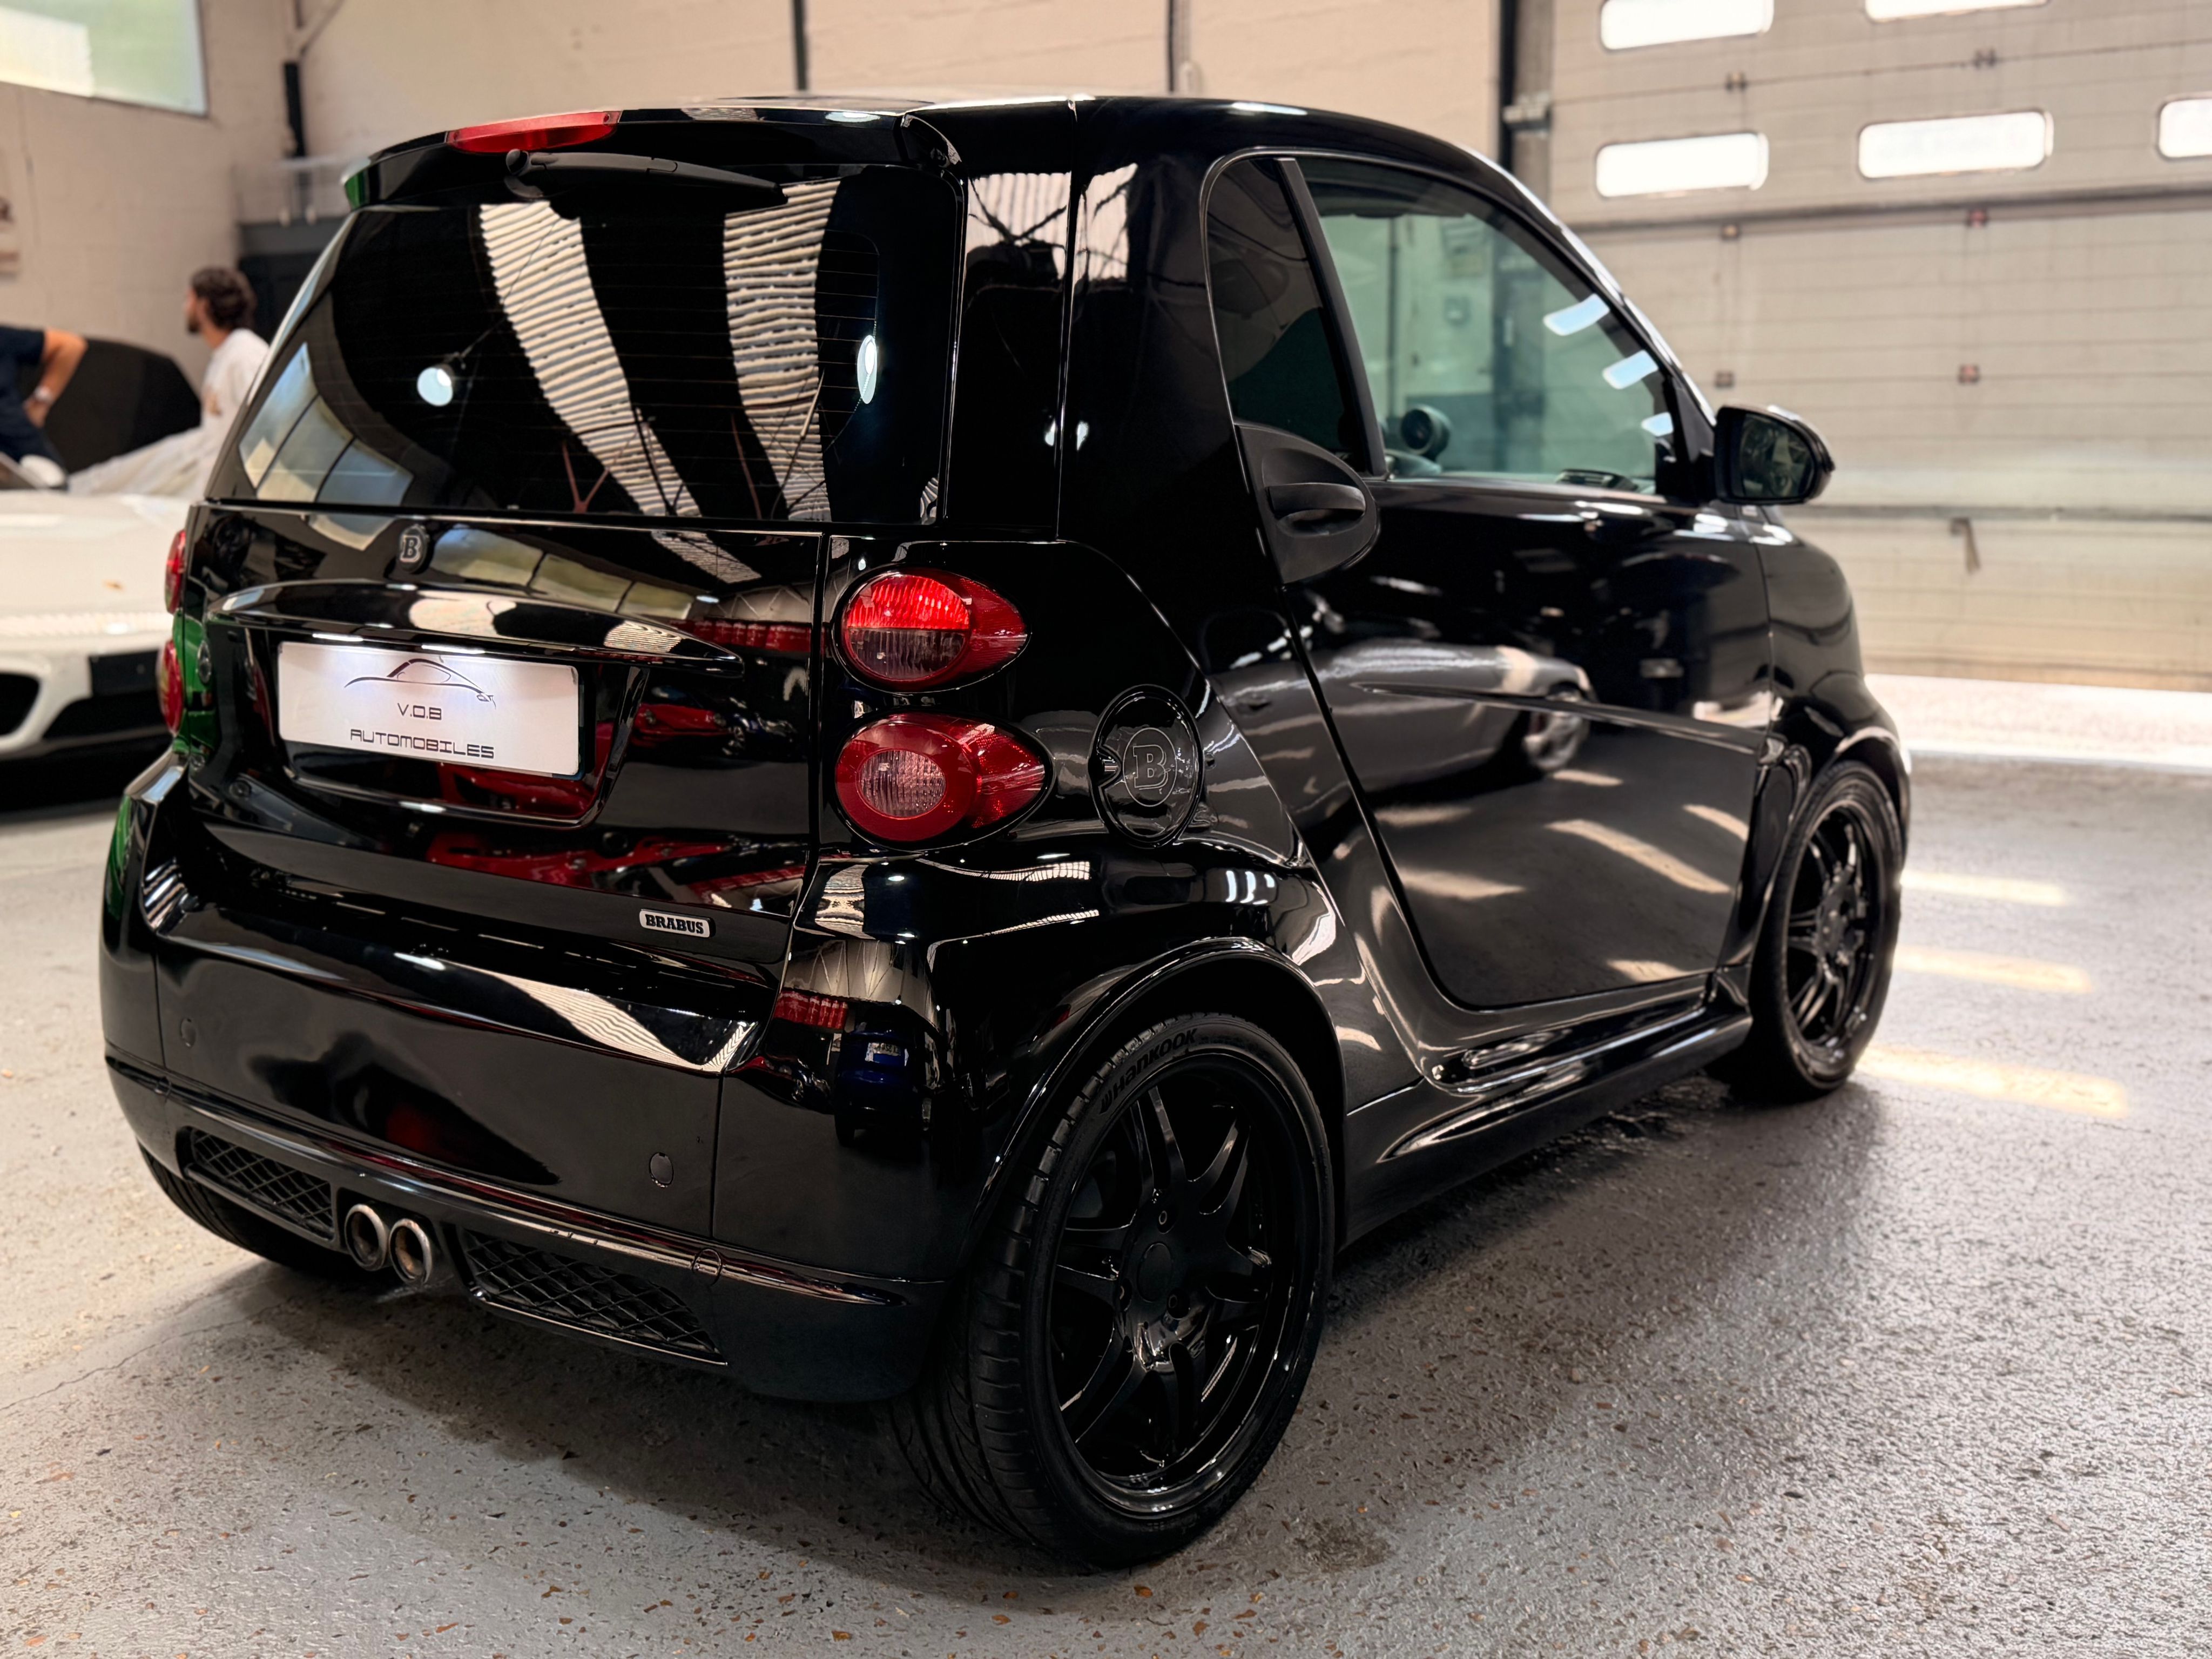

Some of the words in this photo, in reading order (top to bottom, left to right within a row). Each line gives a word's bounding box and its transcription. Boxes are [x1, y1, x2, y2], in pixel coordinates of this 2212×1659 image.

[400, 534, 421, 563] B
[350, 729, 494, 759] AUTOMOBILES
[1133, 745, 1169, 790] B
[645, 914, 704, 934] BRABUS
